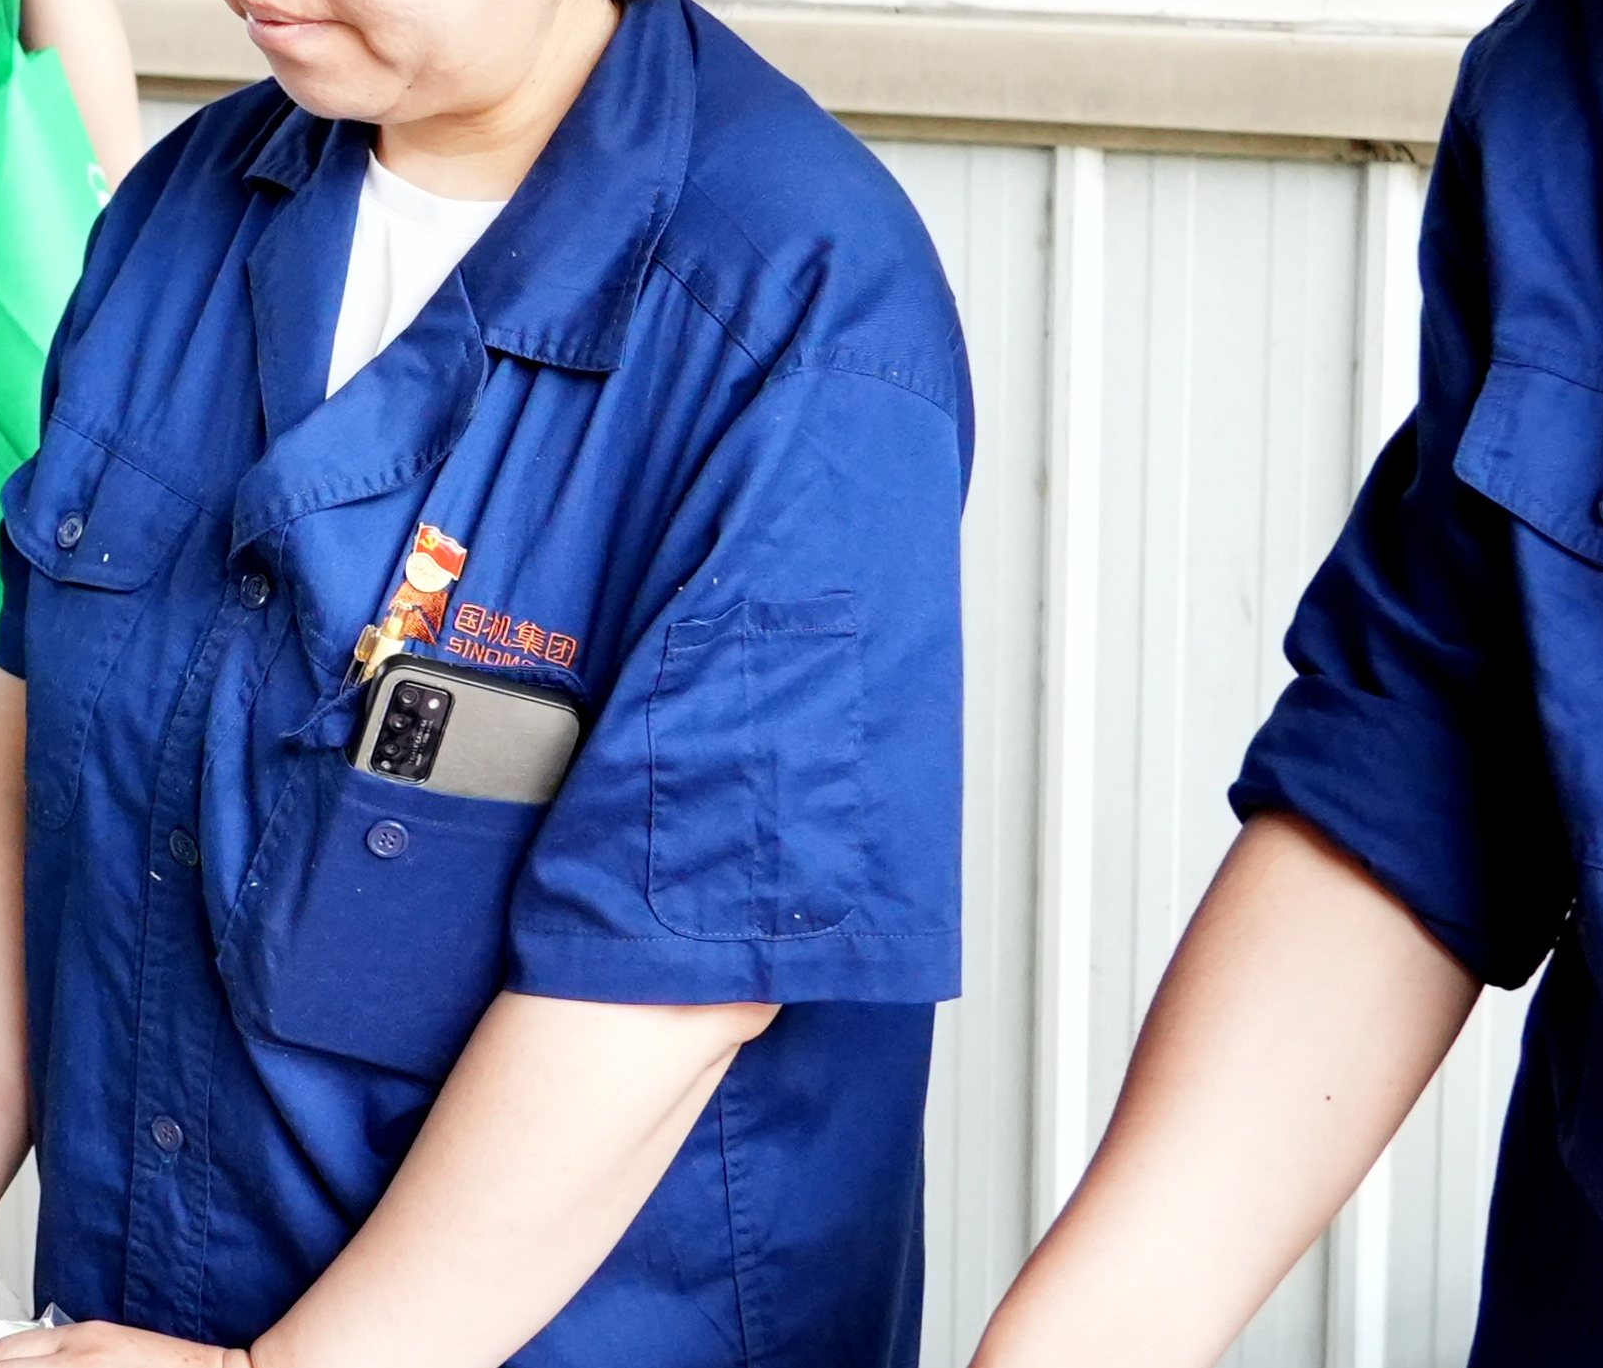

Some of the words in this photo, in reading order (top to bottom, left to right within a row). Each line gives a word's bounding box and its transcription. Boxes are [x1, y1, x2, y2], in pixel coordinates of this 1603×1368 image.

[445, 637, 536, 666] SINOM
[454, 603, 577, 667] 国机集团
